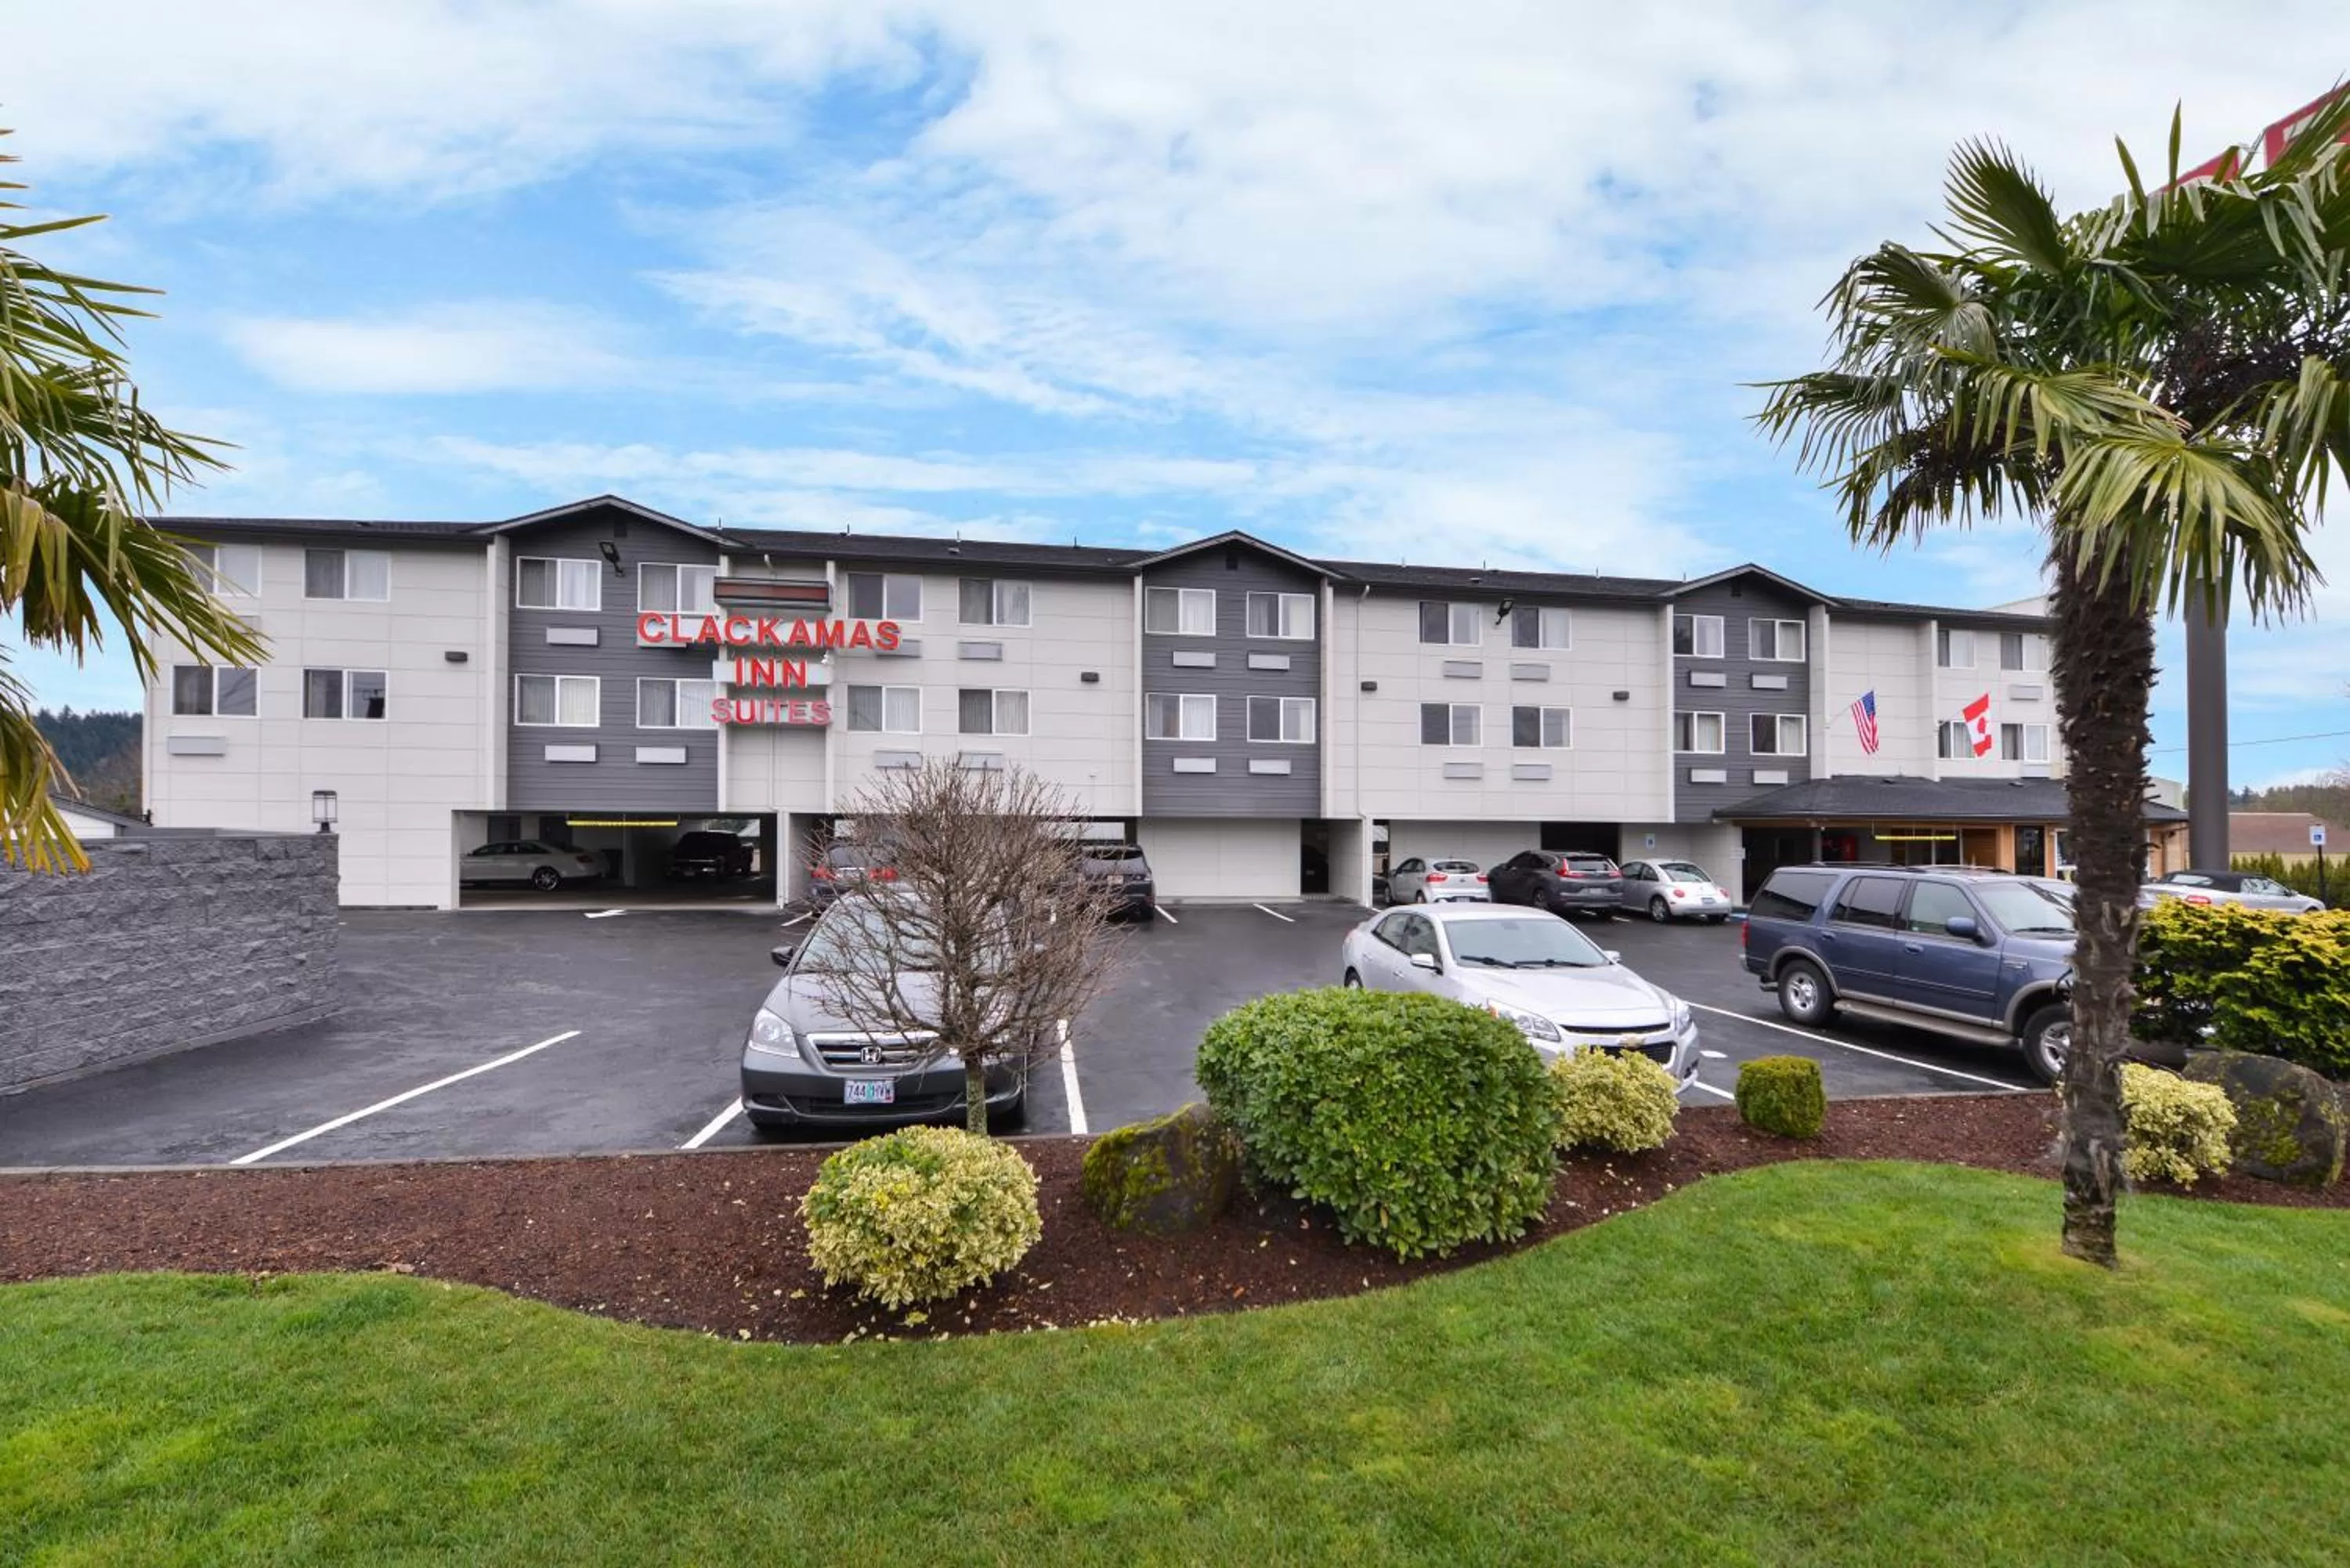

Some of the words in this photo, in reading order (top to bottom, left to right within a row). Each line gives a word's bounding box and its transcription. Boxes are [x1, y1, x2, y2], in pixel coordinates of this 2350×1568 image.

[636, 612, 902, 650] CLACKAMAS
[734, 656, 808, 689] INN
[710, 697, 833, 725] SUITES
[847, 1084, 866, 1097] 744
